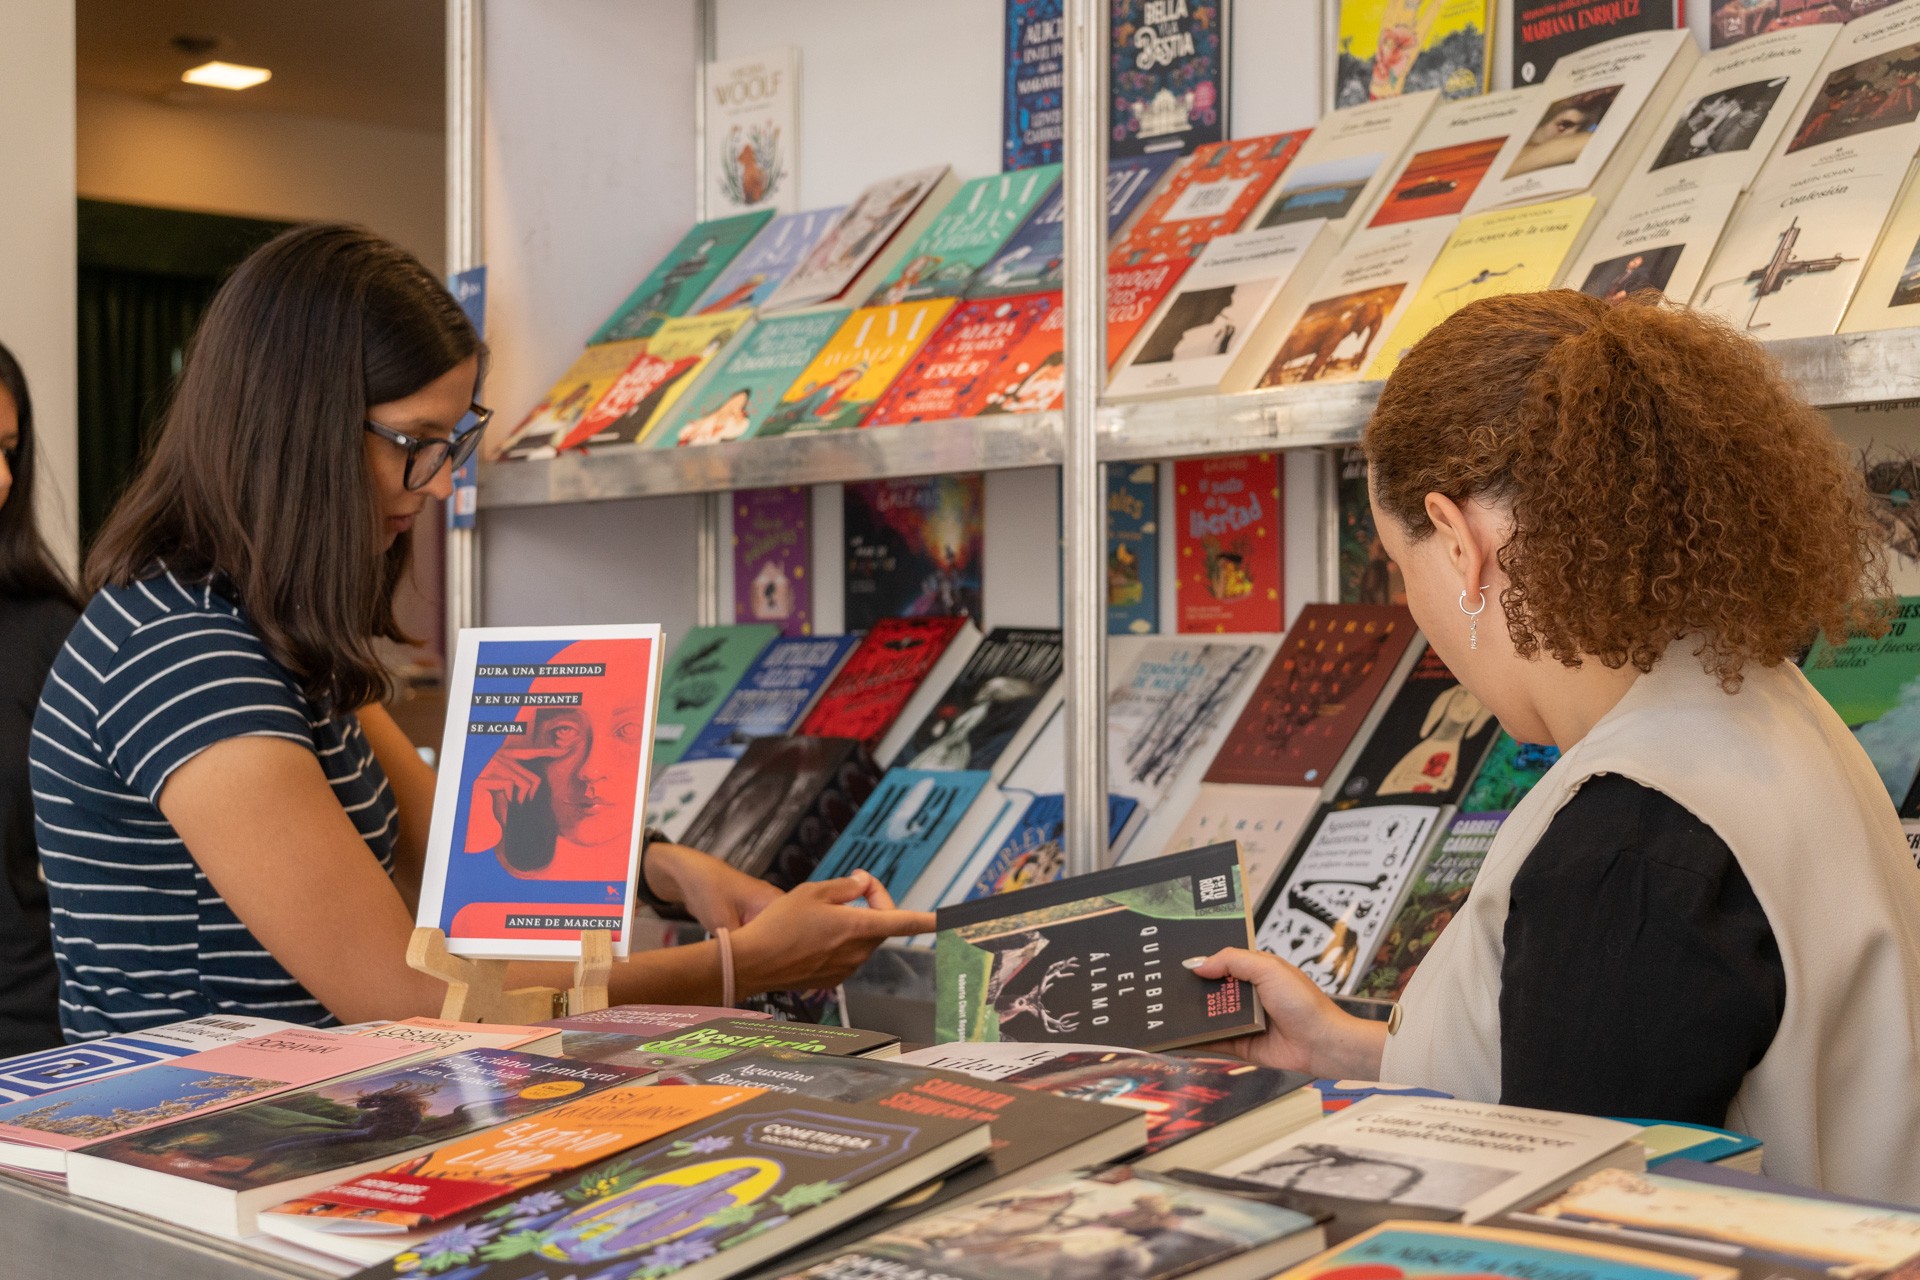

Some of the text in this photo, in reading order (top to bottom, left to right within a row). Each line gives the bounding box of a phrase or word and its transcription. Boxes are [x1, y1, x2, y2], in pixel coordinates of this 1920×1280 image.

[714, 70, 784, 106] WOOLF
[478, 666, 602, 676] DURA UNA ETERNIDAD
[475, 695, 579, 704] Y EN UN INSTANTE
[471, 724, 523, 733] SE ACABA
[1199, 878, 1215, 902] ROCK
[509, 918, 621, 928] ANNE DE MARCKEN
[1117, 971, 1135, 996] EL
[1140, 925, 1164, 1030] QUIEBRA
[1207, 993, 1216, 1017] 2022
[1226, 976, 1236, 1014] PREMIO
[246, 1038, 343, 1056] DORAYAKI
[462, 1050, 627, 1082] Luciano Lamberti
[730, 1064, 815, 1083] Agustina
[706, 1073, 798, 1094] Bazterrica
[1416, 1103, 1562, 1126] MARIANA ENRIQUEZ
[760, 1134, 842, 1154] DOLORES REYES
[762, 1123, 873, 1150] COMETIERRA
[1355, 1126, 1536, 1153] completamente
[1425, 1122, 1575, 1148] desaparecer
